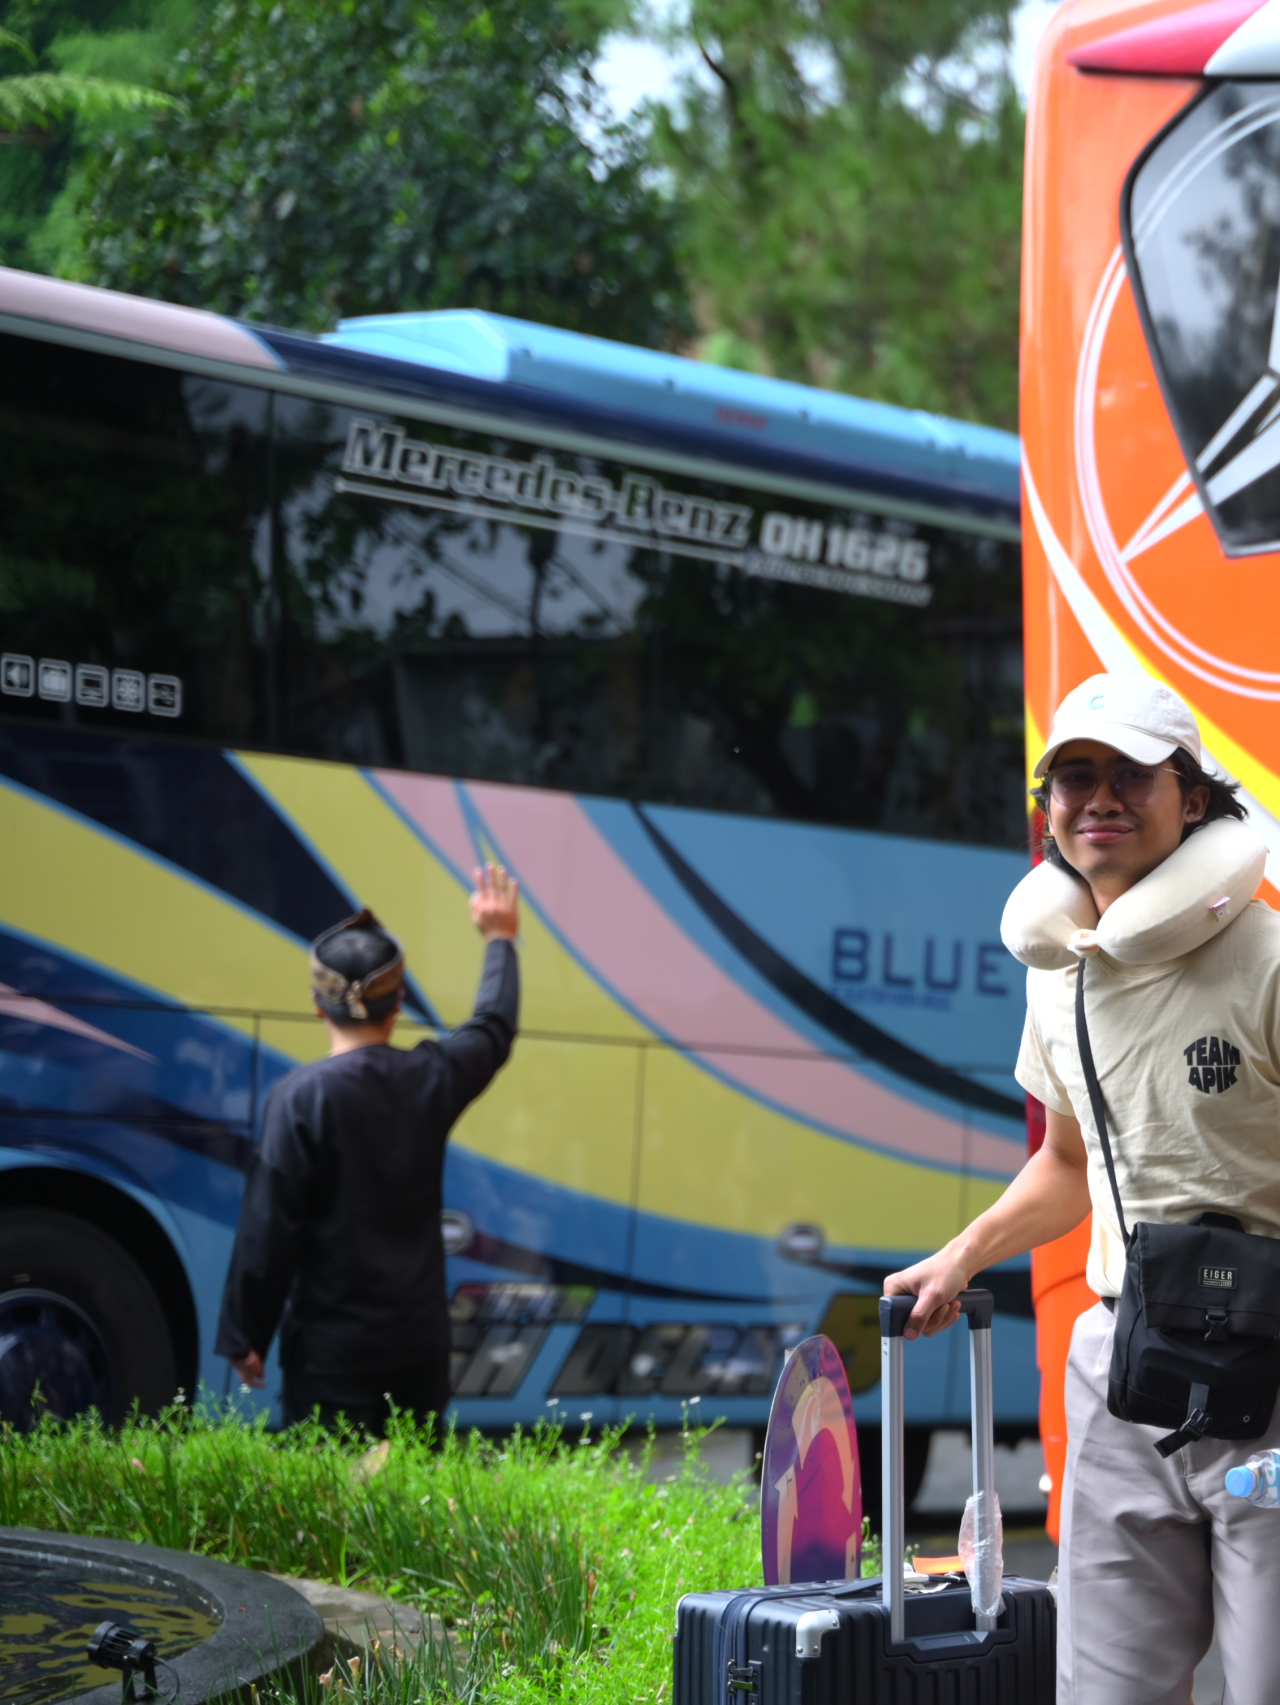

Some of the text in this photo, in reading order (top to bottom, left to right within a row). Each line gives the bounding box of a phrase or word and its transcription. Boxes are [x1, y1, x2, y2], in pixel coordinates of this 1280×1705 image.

[832, 927, 1008, 997] BLUE
[1183, 1035, 1241, 1067] TEAM
[1188, 1066, 1238, 1094] APIK
[1203, 1269, 1233, 1280] EIGER
